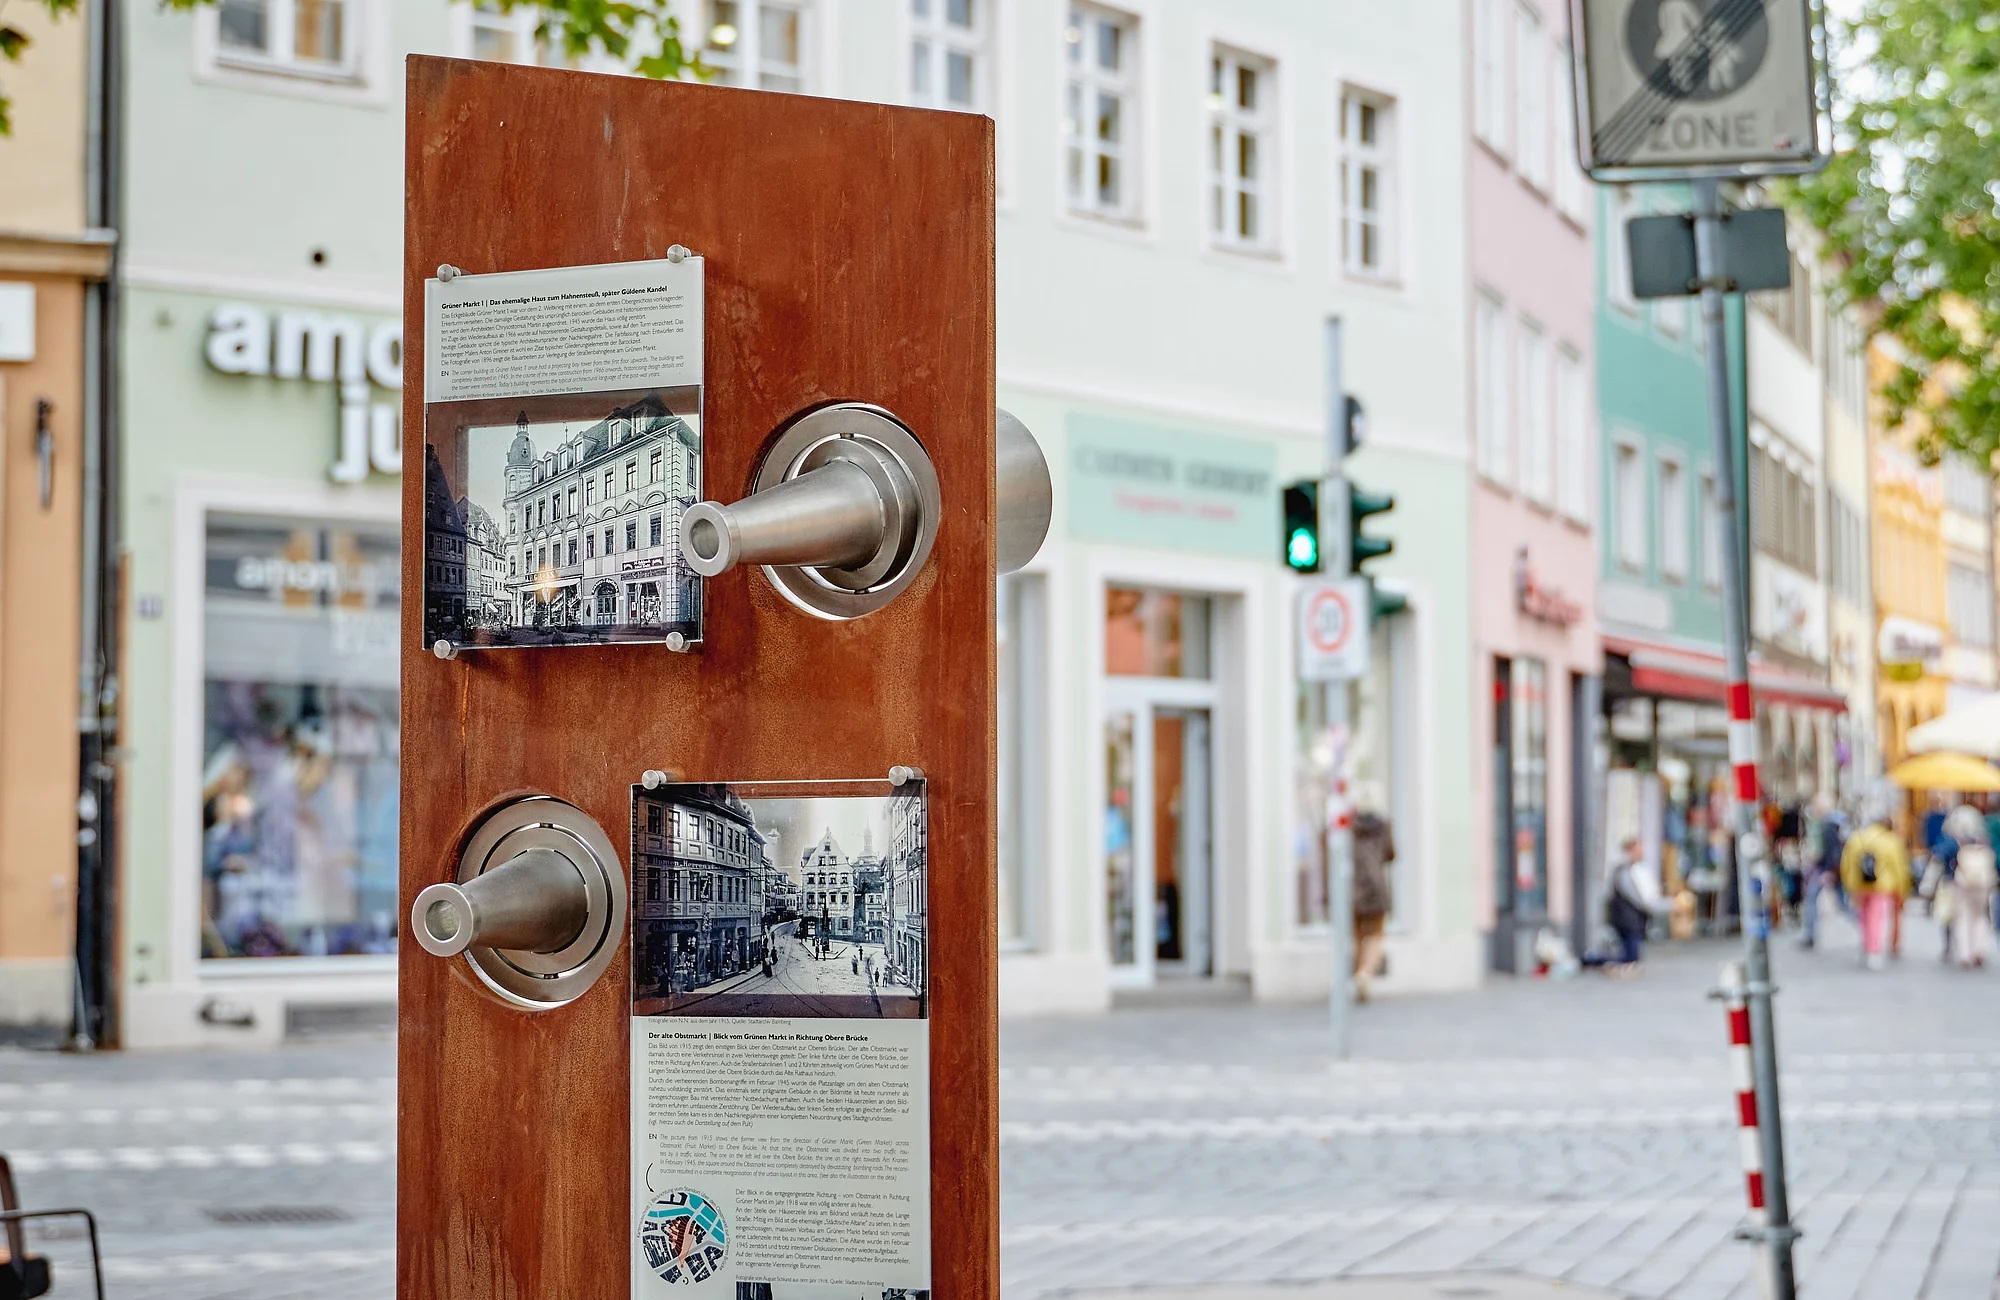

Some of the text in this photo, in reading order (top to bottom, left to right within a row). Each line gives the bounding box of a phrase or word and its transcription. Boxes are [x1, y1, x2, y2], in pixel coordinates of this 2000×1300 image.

[463, 300, 480, 308] Markt
[502, 296, 530, 305] ehemalige
[602, 289, 620, 298] später
[647, 285, 667, 293] Kandel
[796, 1033, 823, 1042] Richtung
